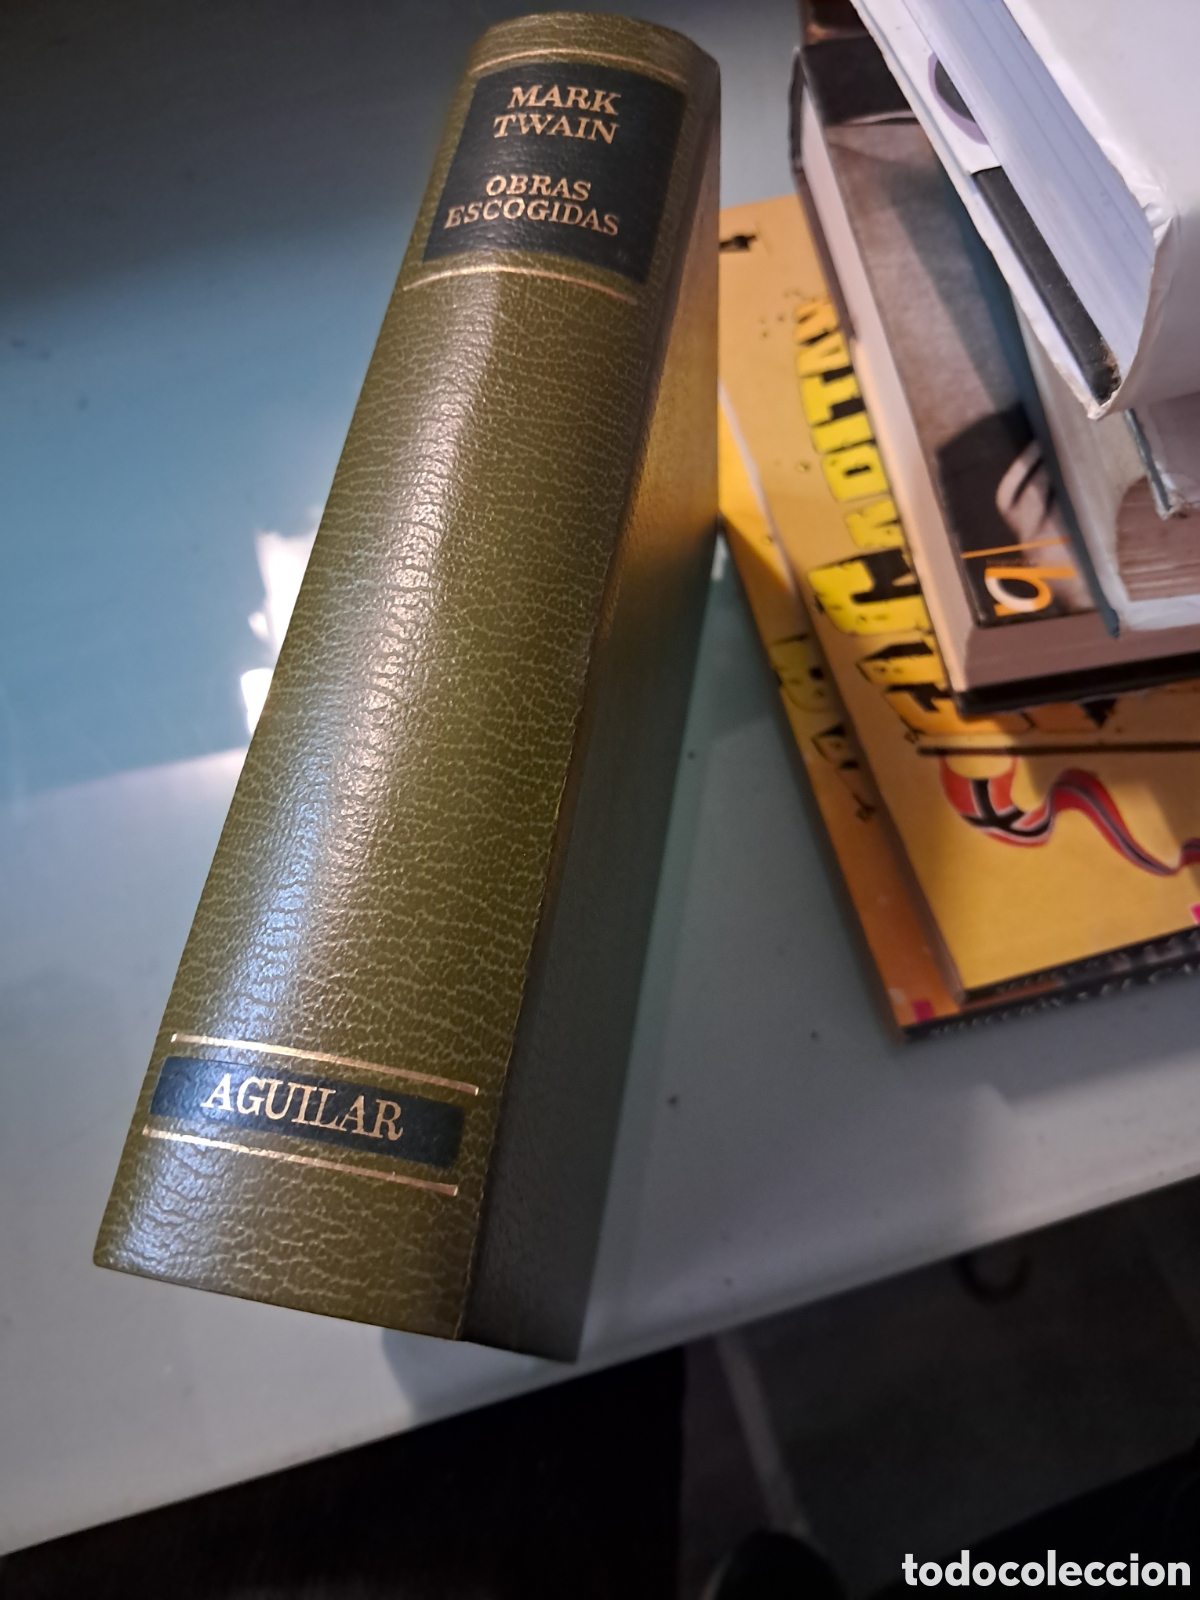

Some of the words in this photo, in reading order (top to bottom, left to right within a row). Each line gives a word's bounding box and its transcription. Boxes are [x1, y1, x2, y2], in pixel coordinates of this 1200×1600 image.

[507, 84, 621, 116] MARK
[493, 113, 620, 145] TWAIN
[486, 174, 592, 201] OBRAS
[444, 197, 620, 236] ESCOGIDAS
[200, 1073, 404, 1141] AGUILAR
